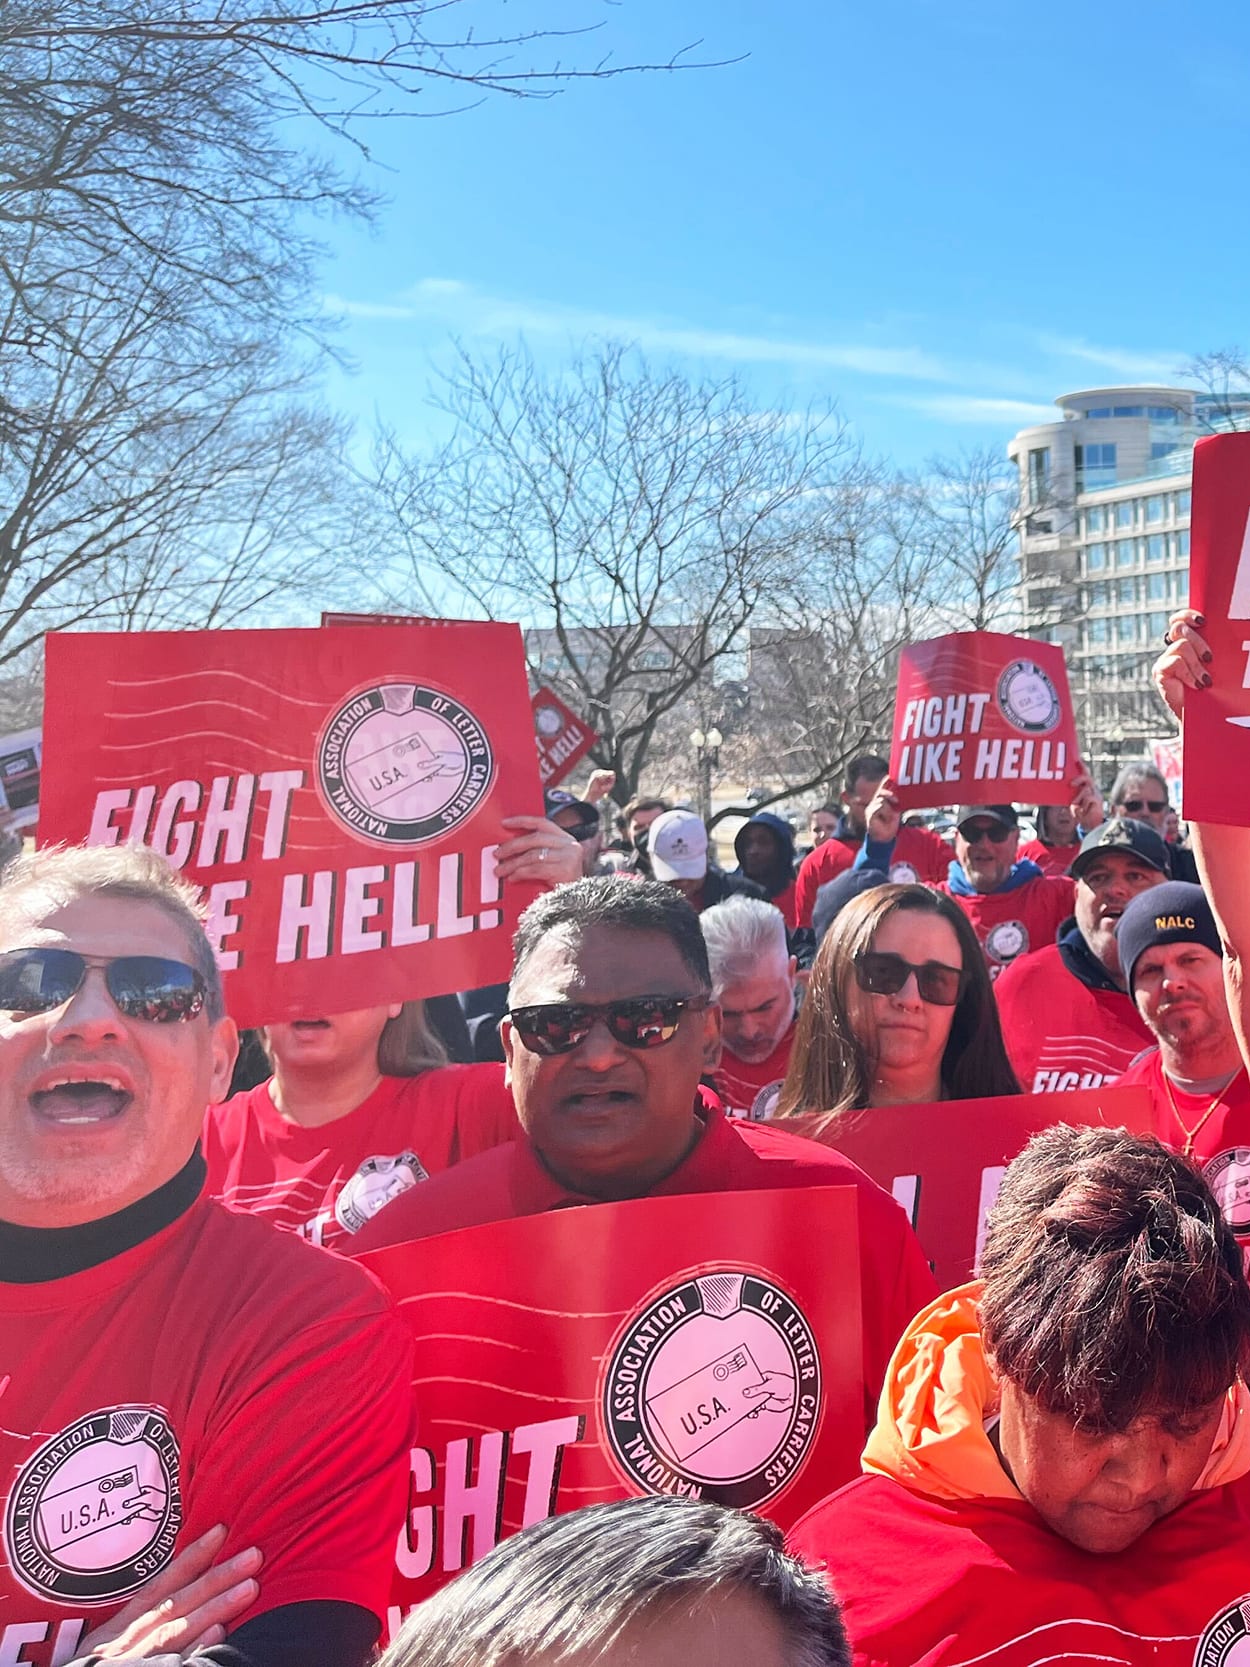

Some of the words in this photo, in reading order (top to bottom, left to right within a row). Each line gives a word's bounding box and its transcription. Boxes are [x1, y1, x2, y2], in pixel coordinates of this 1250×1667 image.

[430, 697, 451, 714] OF
[900, 693, 991, 742] FIGHT
[325, 698, 373, 780] ASSOCIATION
[452, 713, 485, 757] LETTER
[897, 740, 965, 786] LIKE
[974, 739, 1066, 780] HELL!
[369, 766, 408, 792] U.S.A.
[440, 764, 488, 825] CARRIERS
[87, 770, 307, 871] FIGHT
[331, 786, 389, 836] NATIONAL
[276, 845, 503, 964] HELL!
[1155, 916, 1195, 930] NALC
[760, 1290, 783, 1314] OF
[615, 1296, 687, 1422] ASSOCIATION
[783, 1314, 815, 1380] LETTER
[680, 1397, 731, 1435] U.S.A.
[765, 1394, 816, 1487] CARRIERS
[19, 1424, 95, 1516] ASSOCIATION
[624, 1433, 702, 1500] NATIONAL
[61, 1498, 116, 1534] U.S.A.
[395, 1415, 586, 1579] GHT
[16, 1526, 61, 1586] NATIONAL
[1203, 1620, 1236, 1667] IATION
